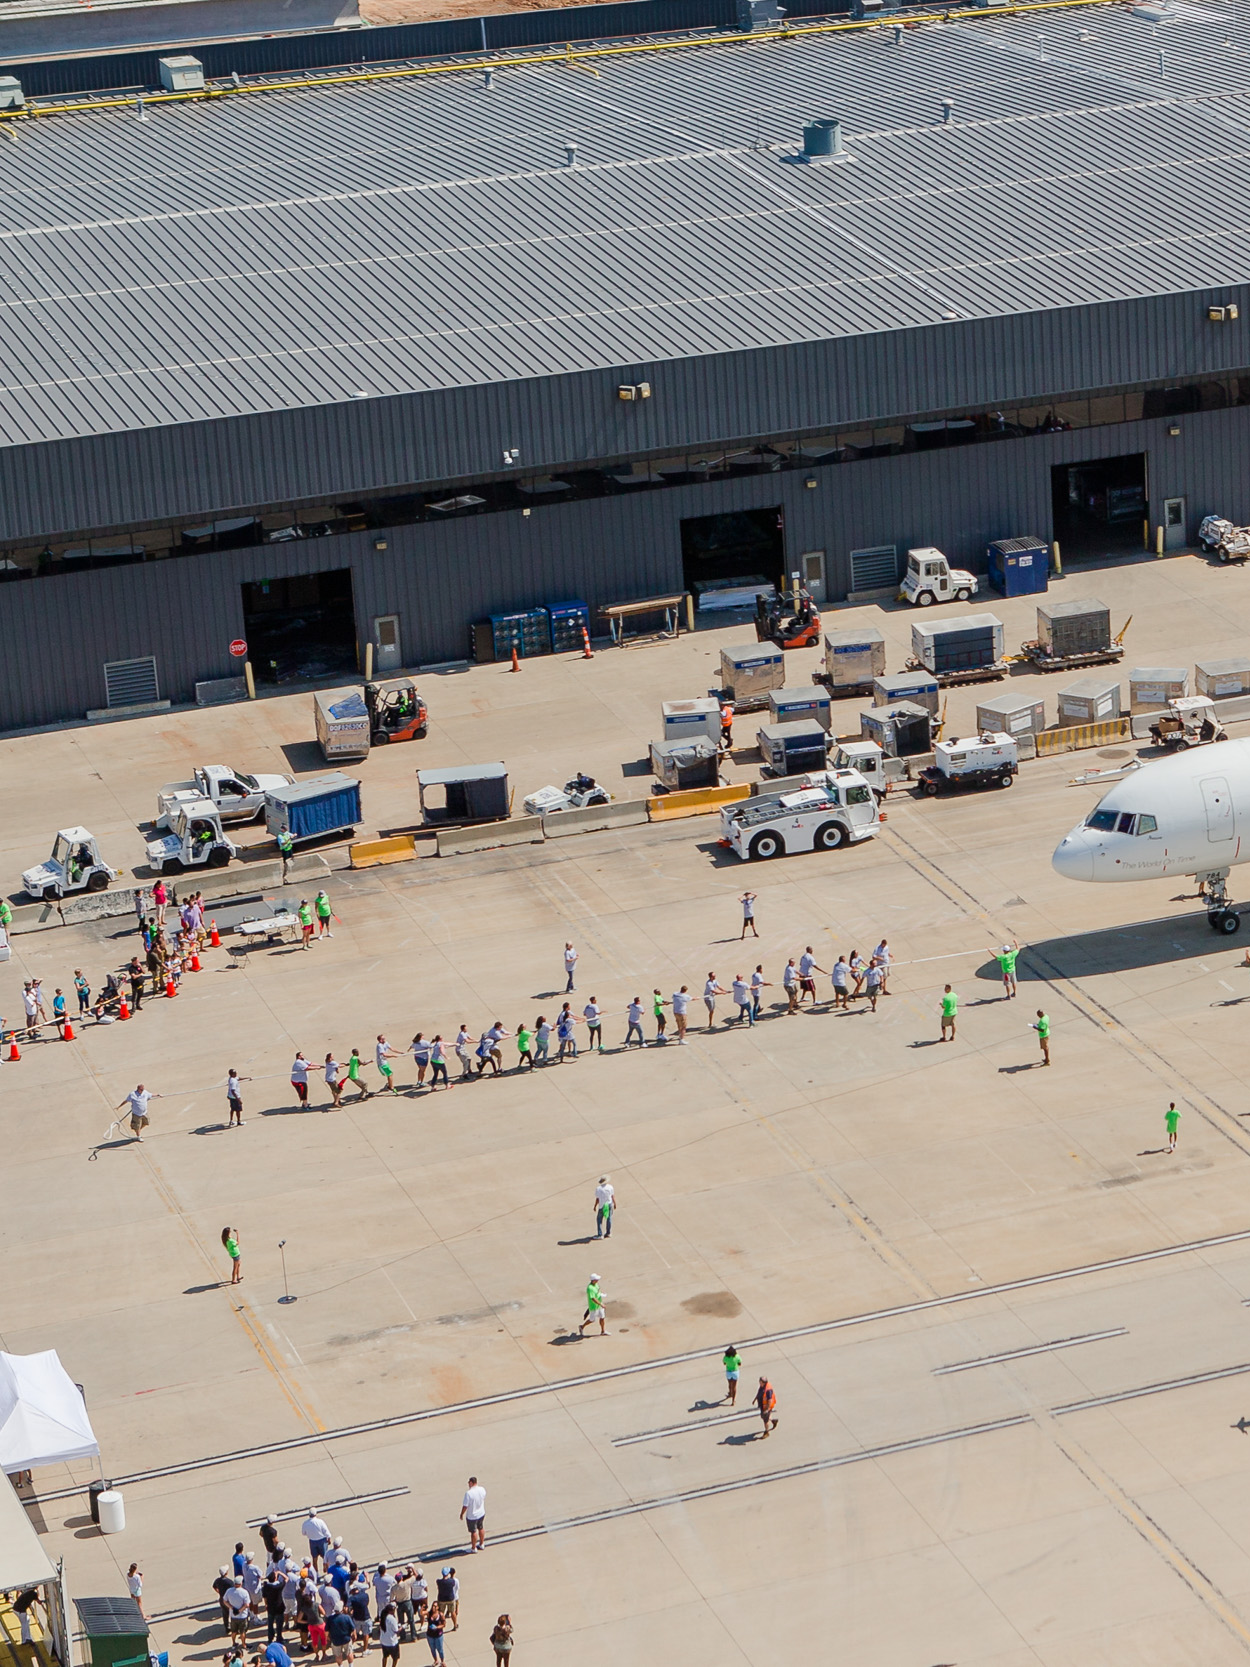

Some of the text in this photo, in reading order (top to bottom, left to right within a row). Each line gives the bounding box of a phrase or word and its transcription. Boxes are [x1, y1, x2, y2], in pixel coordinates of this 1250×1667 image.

[1122, 861, 1136, 869] The
[1138, 859, 1161, 868] World
[1163, 858, 1175, 866] On
